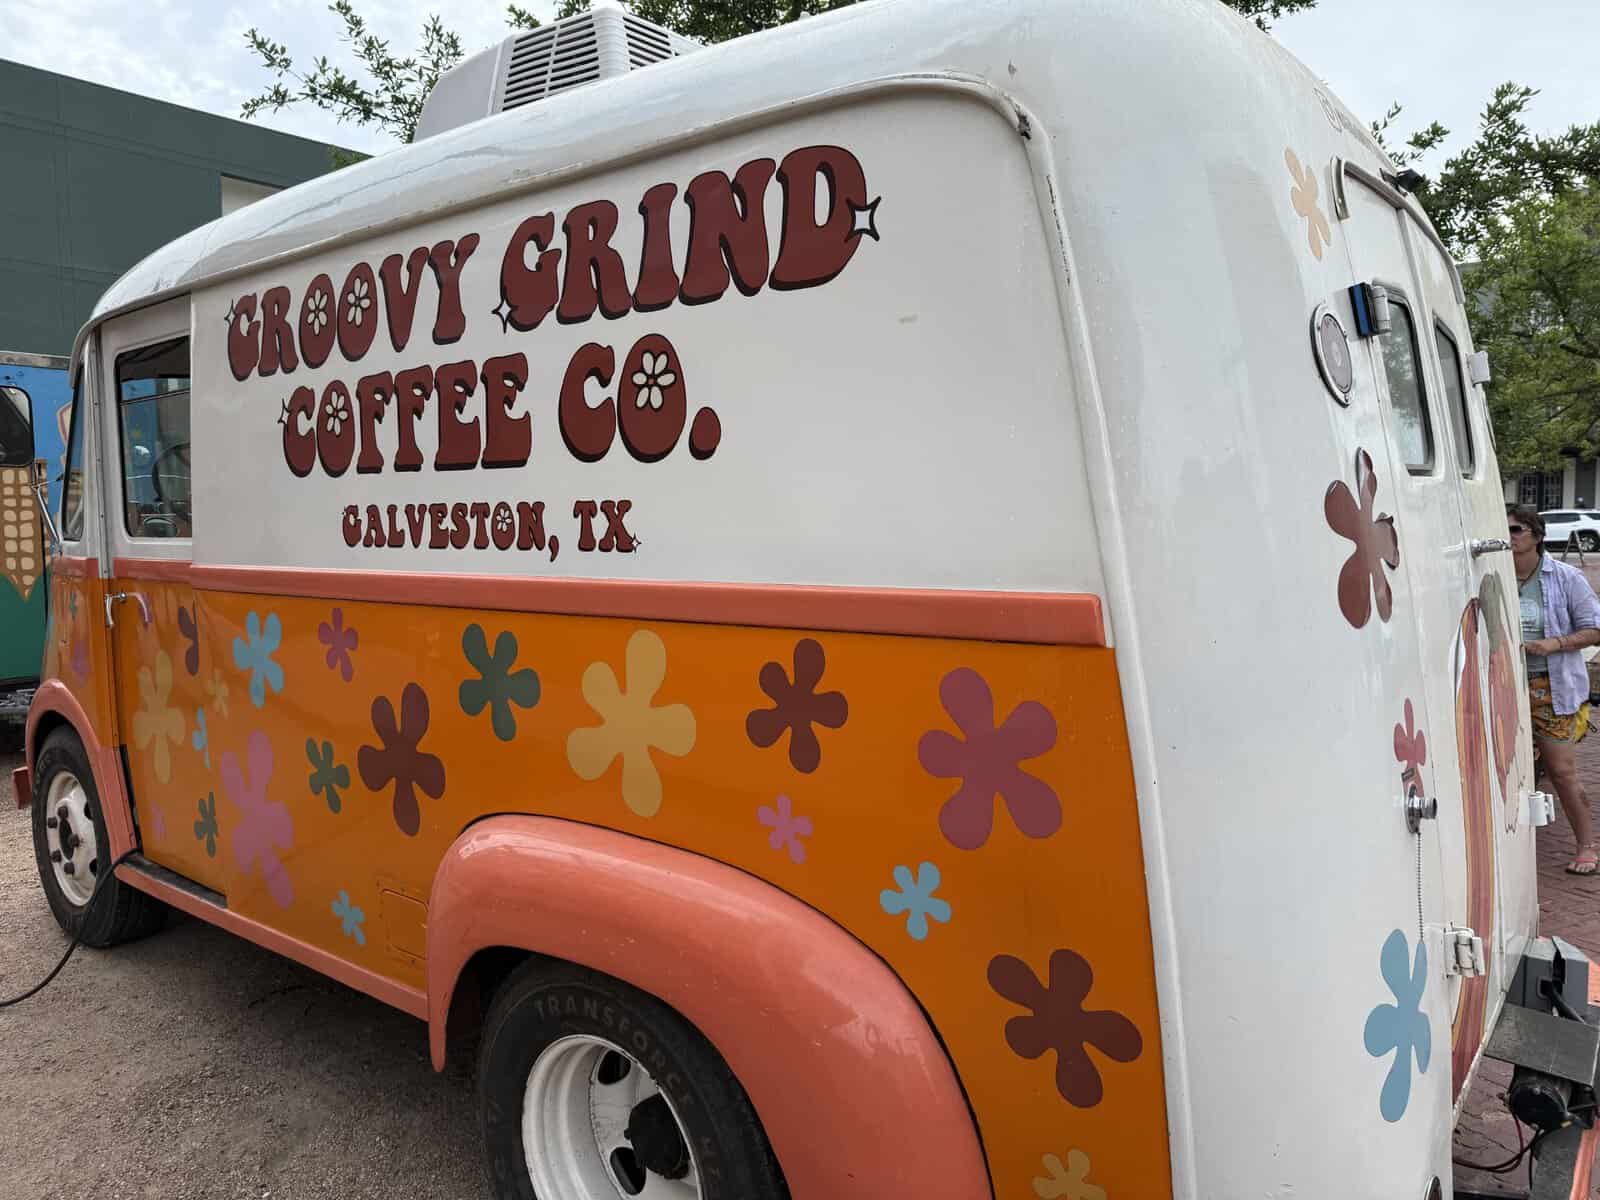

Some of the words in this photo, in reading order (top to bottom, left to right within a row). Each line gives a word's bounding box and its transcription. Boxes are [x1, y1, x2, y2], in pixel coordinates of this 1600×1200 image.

[227, 232, 480, 382] GROOVY
[498, 144, 870, 333] GRIND
[281, 352, 533, 479] COFFEE
[557, 332, 722, 464] CO.
[341, 500, 561, 563] GALVESTON,
[572, 499, 636, 555] TX
